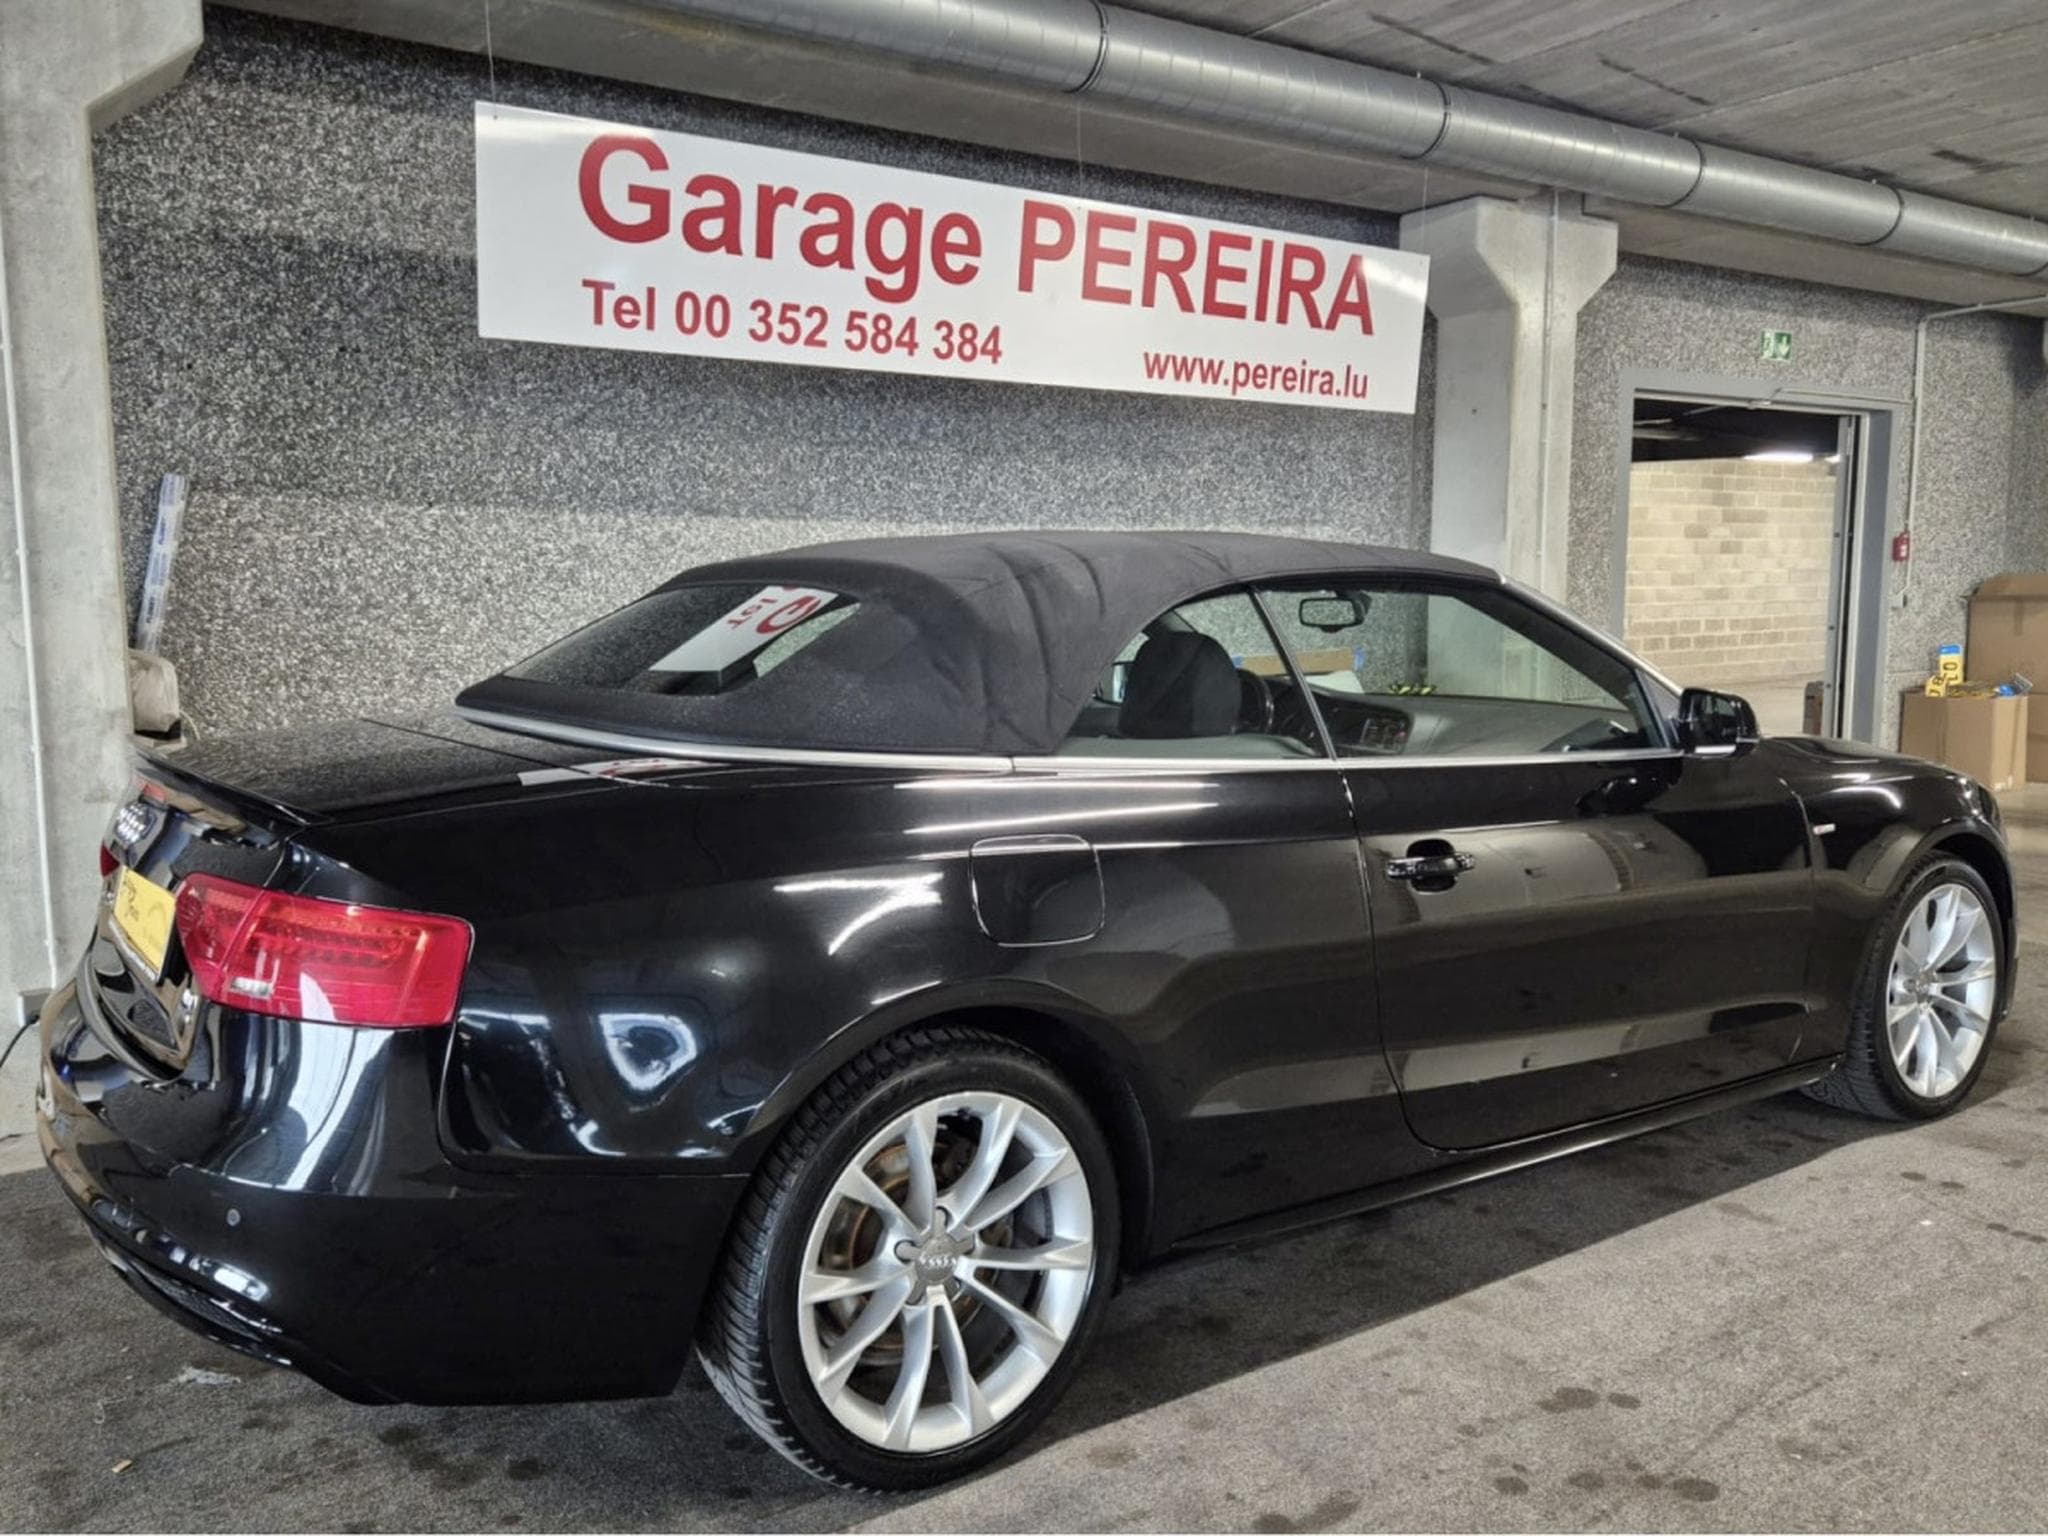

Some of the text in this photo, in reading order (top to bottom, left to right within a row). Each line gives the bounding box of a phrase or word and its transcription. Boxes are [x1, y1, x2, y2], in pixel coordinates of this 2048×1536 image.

[578, 133, 1375, 337] Garage PEREIRA
[581, 279, 1004, 365] Tel 00 352 584 384
[1143, 351, 1369, 400] www.pereira.lu
